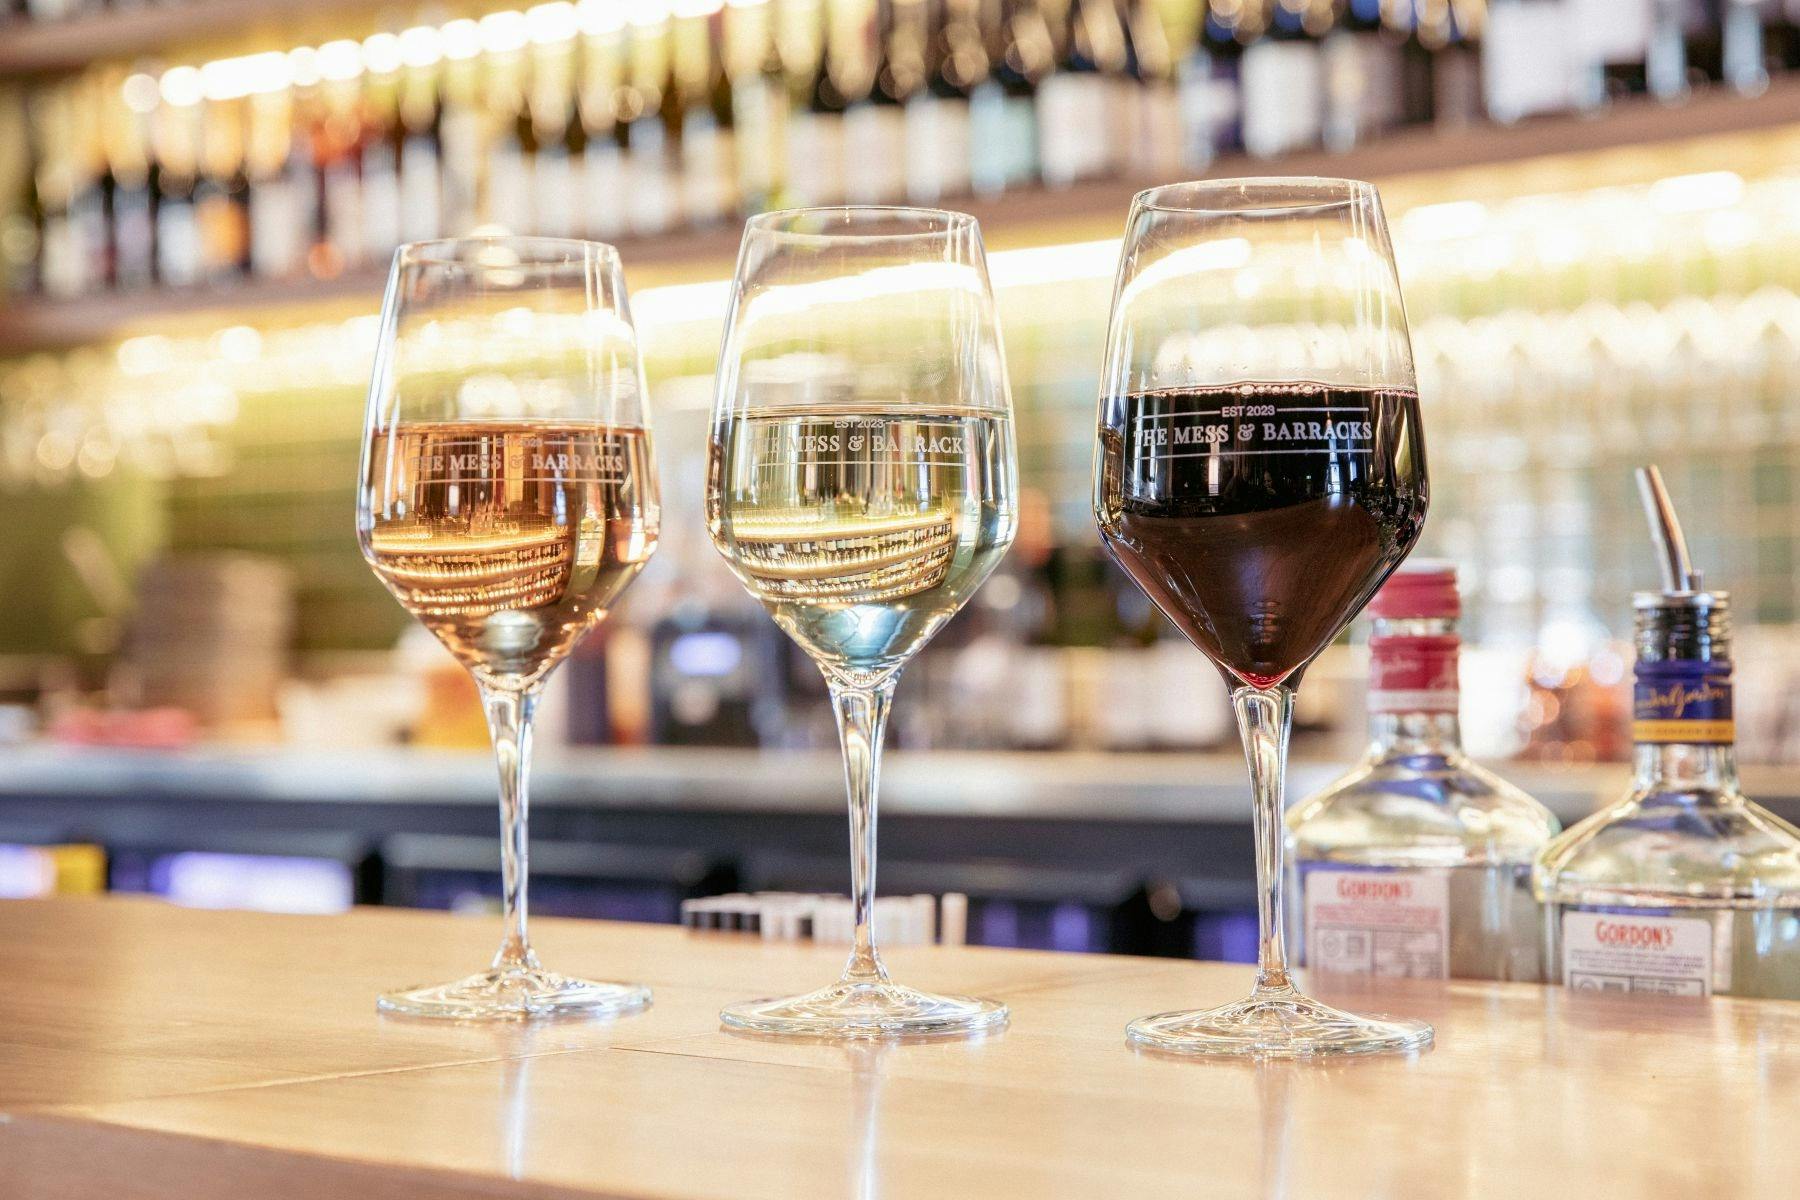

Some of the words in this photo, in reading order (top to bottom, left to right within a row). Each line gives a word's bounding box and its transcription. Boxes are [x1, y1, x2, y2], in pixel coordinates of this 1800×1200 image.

[1222, 406, 1243, 418] EST
[1247, 404, 1275, 417] 2023
[857, 418, 886, 429] 2023
[848, 434, 865, 452] &
[1133, 428, 1168, 447] THE
[1173, 424, 1229, 444] MESS
[1237, 423, 1255, 441] &
[1263, 421, 1373, 441] BARRACKS
[449, 453, 502, 471] MESS
[532, 453, 624, 472] BARRACKS
